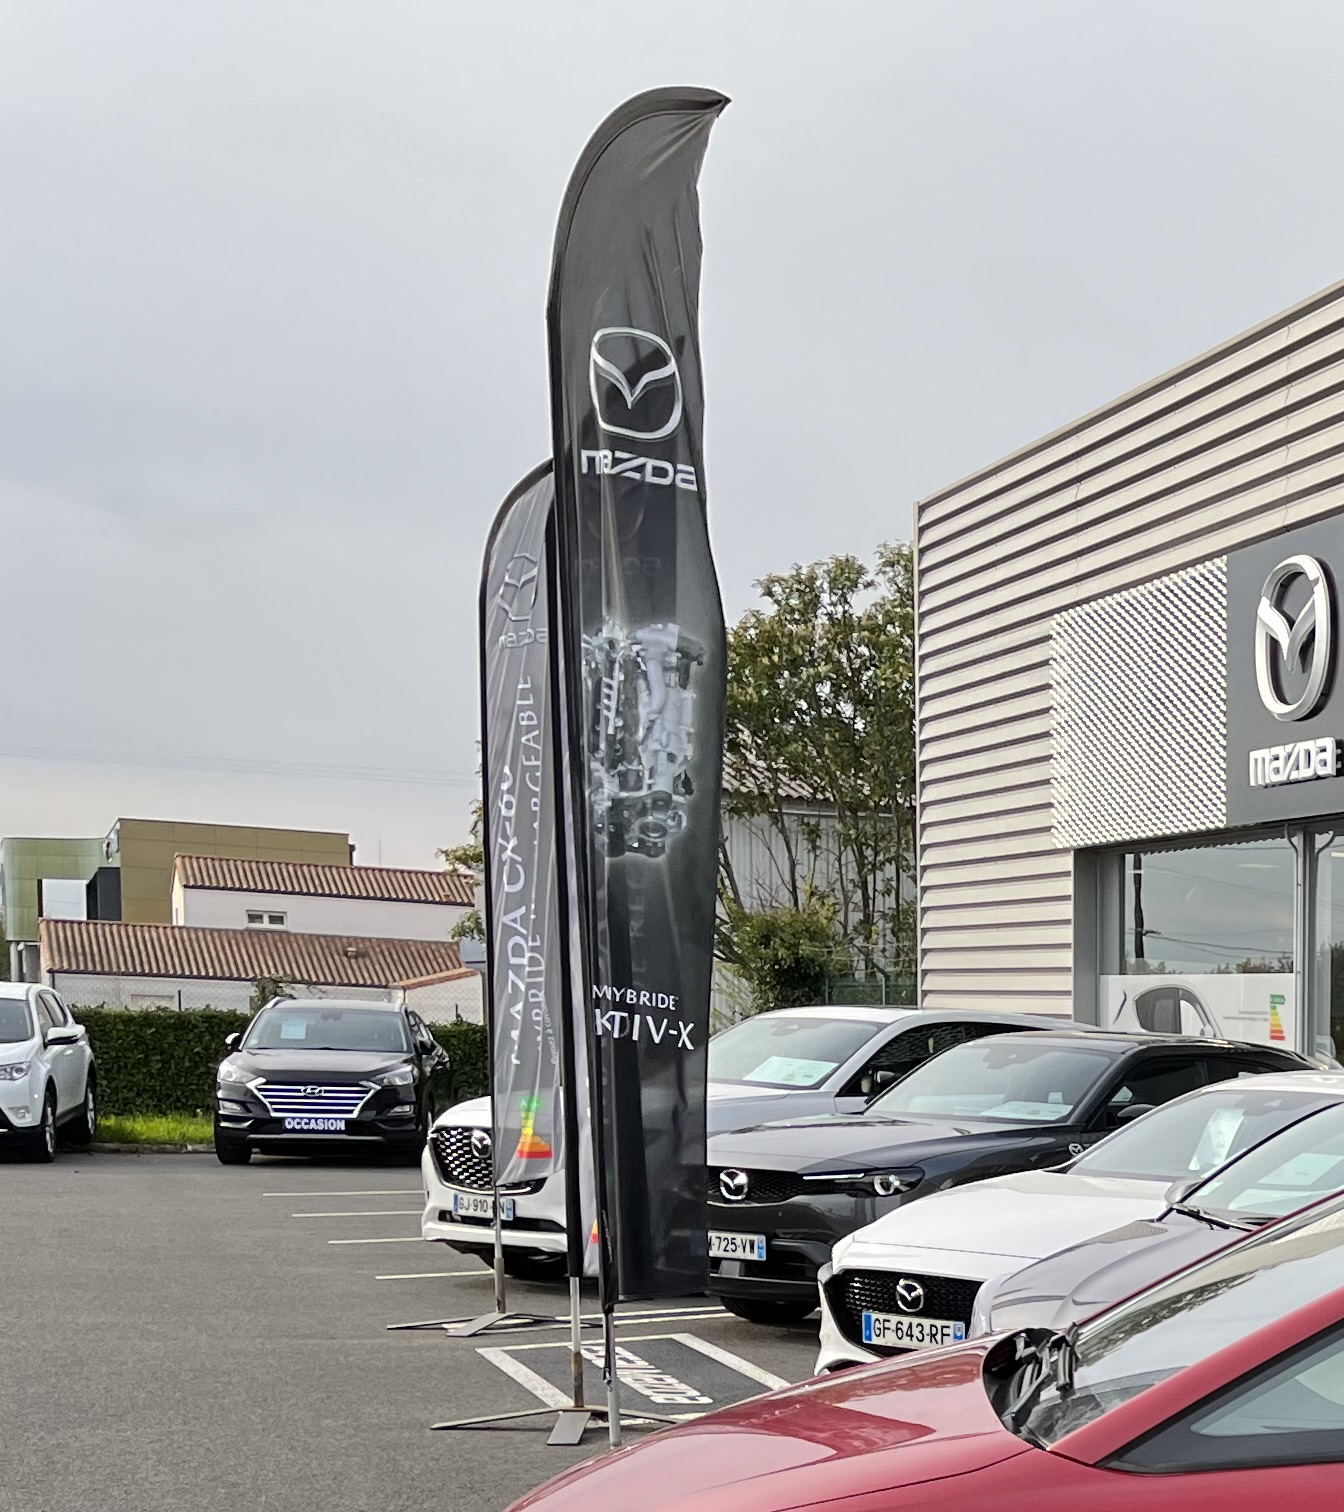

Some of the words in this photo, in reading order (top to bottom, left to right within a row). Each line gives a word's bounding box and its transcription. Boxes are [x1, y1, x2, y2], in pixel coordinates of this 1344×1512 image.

[581, 449, 698, 491] mazda
[1249, 737, 1338, 787] mazda
[284, 1118, 345, 1131] OCCASION
[873, 1317, 951, 1346] GF-643-RF
